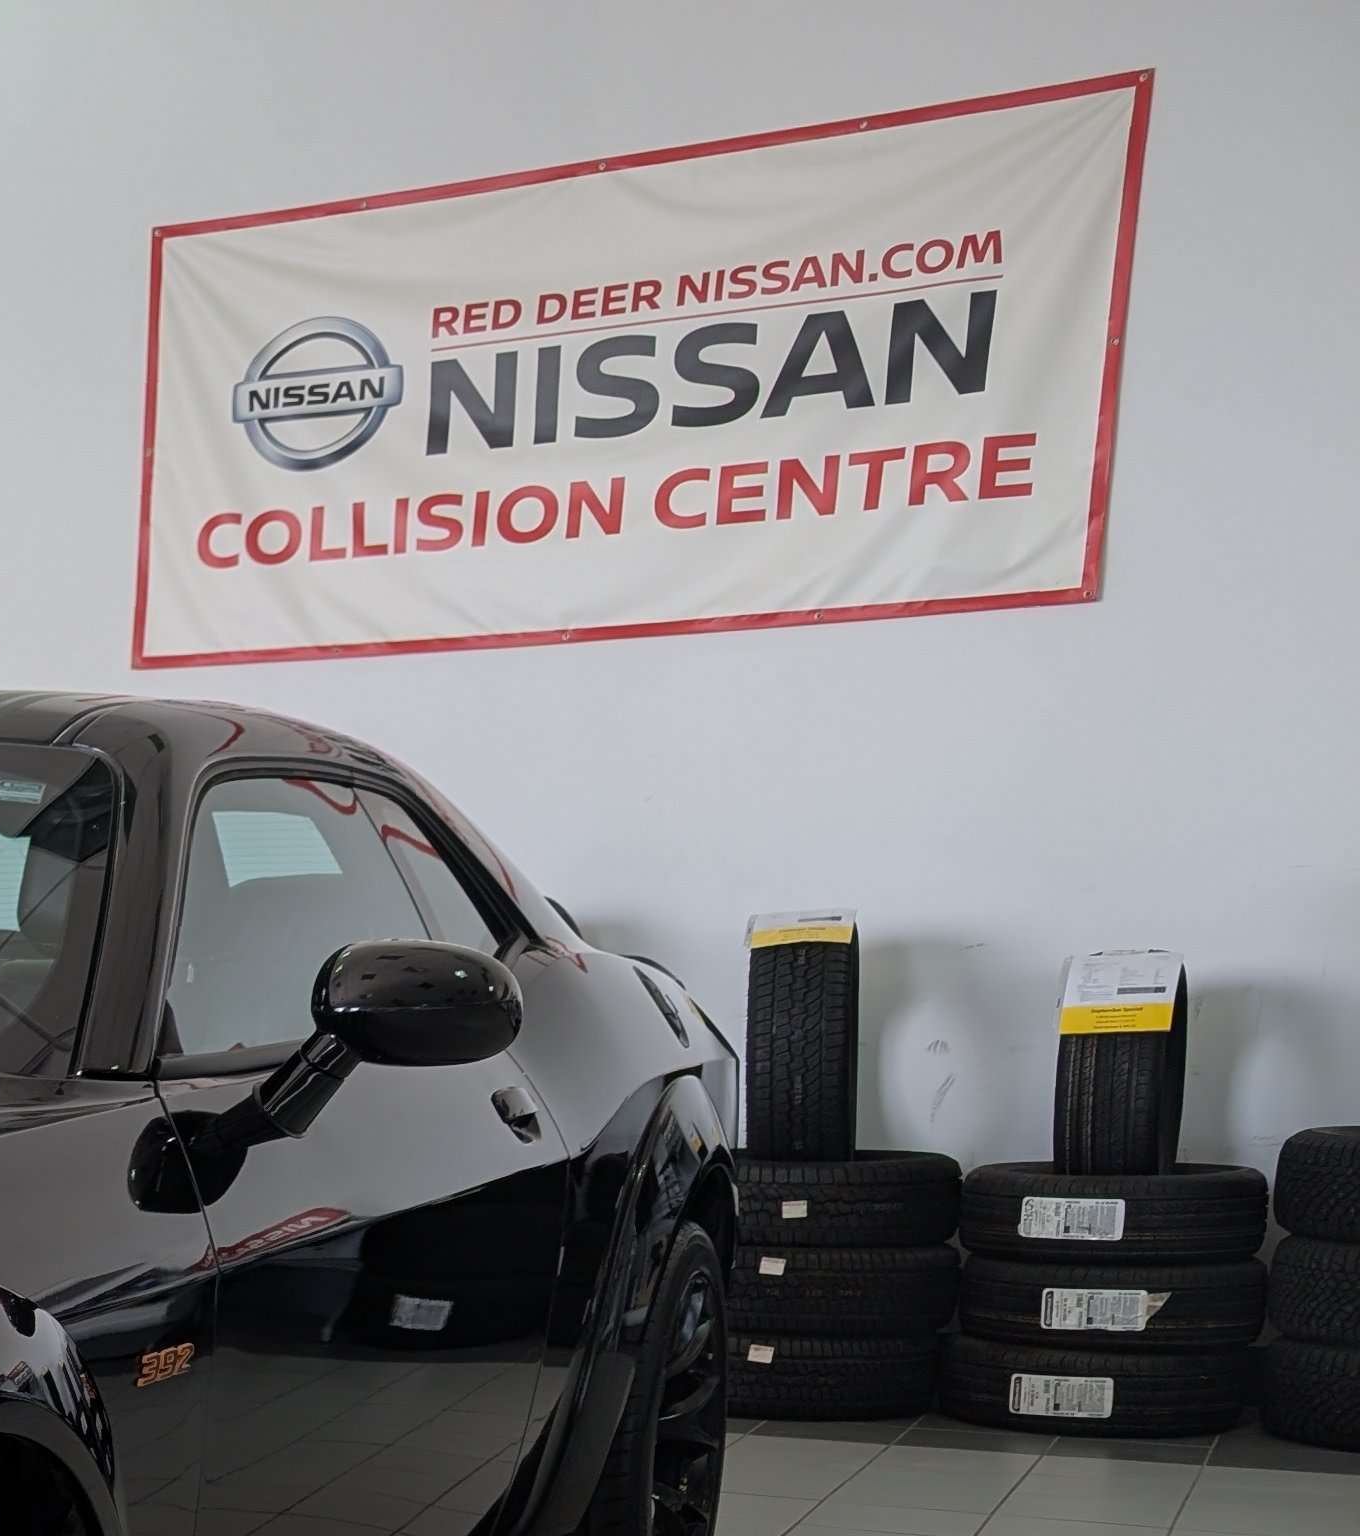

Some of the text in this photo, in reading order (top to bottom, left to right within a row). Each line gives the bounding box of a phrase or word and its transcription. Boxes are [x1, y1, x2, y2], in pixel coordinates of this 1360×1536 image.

[432, 230, 1003, 339] RED DEER NISSAN.COM
[248, 375, 385, 412] NISSAN
[426, 290, 998, 455] NISSAN
[197, 433, 1036, 568] COLLISION CENTRE
[137, 1342, 195, 1387] 392
